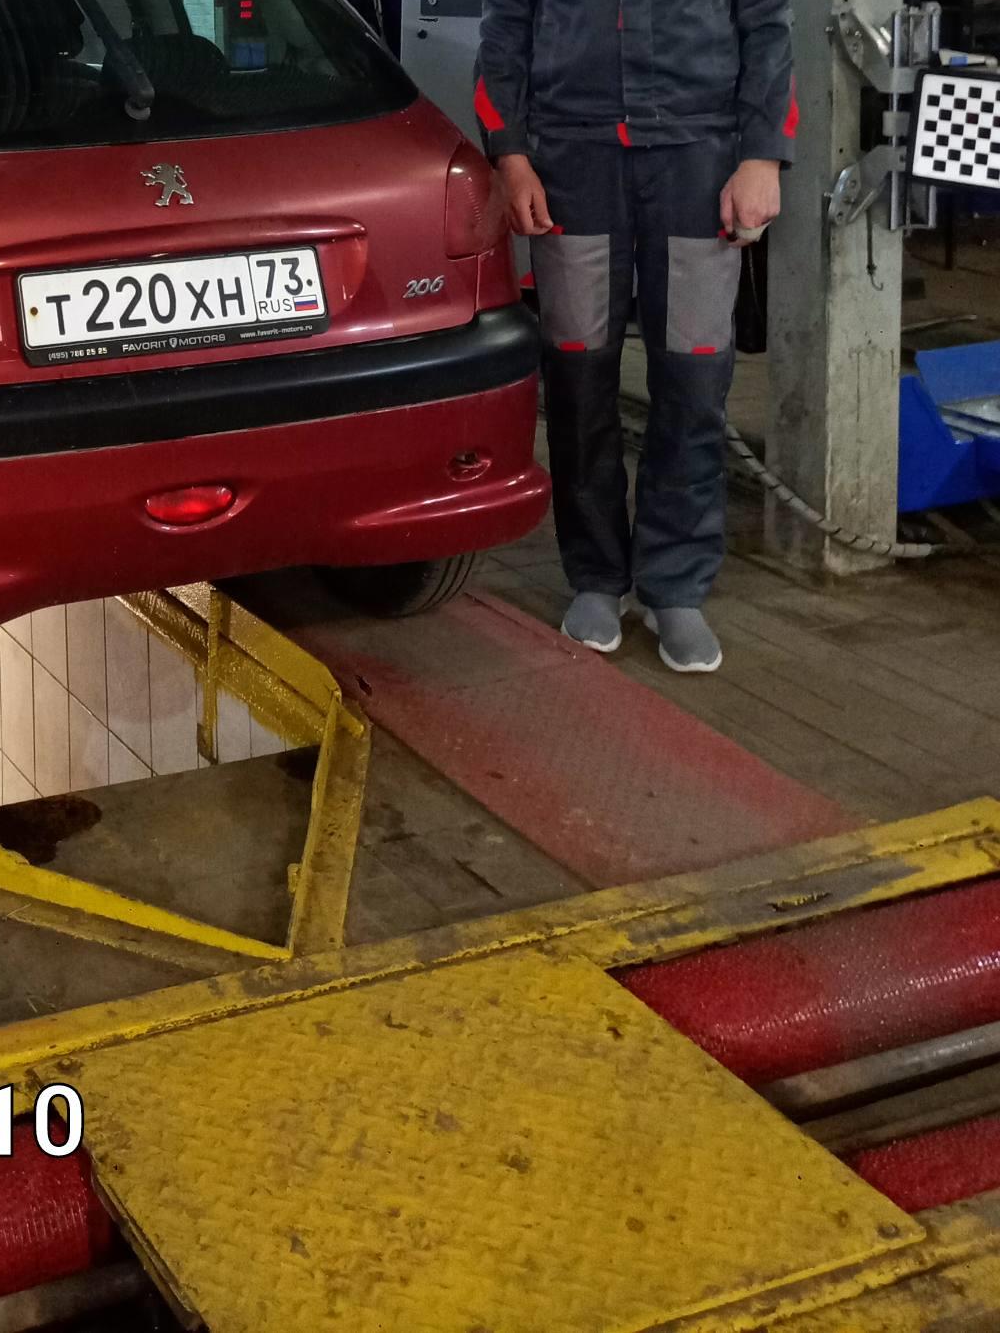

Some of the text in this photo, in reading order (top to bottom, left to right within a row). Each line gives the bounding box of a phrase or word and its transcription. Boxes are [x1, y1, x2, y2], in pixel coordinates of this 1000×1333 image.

[256, 257, 304, 299] 73
[402, 275, 445, 298] 206
[258, 297, 293, 315] RUS
[122, 333, 226, 353] FAVORIT MOTORS
